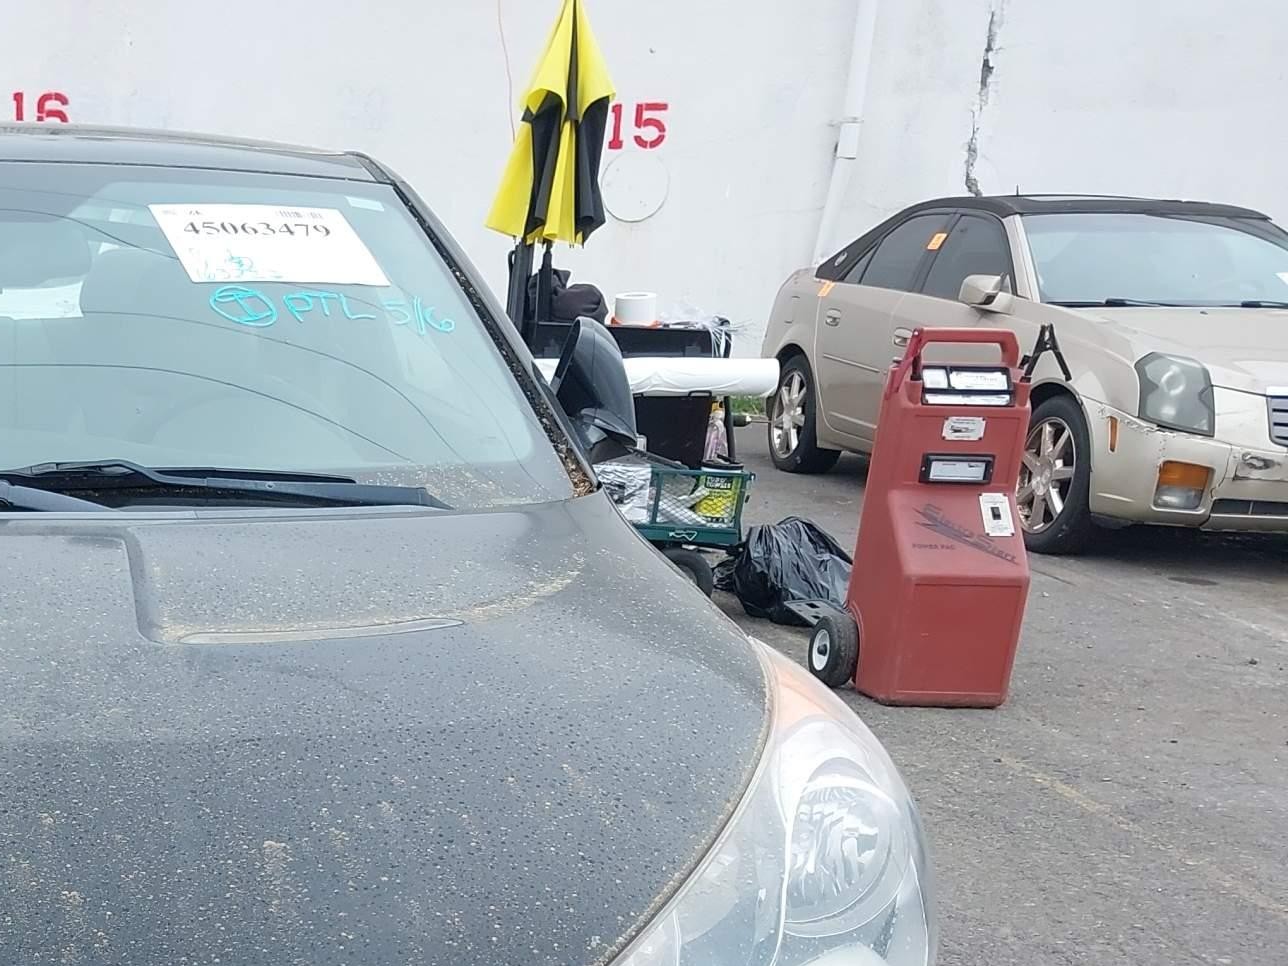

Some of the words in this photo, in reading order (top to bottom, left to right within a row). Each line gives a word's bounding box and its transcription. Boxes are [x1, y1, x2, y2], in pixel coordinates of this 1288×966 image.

[12, 91, 69, 123] 16
[608, 102, 669, 150] 15
[183, 221, 332, 238] 45063479
